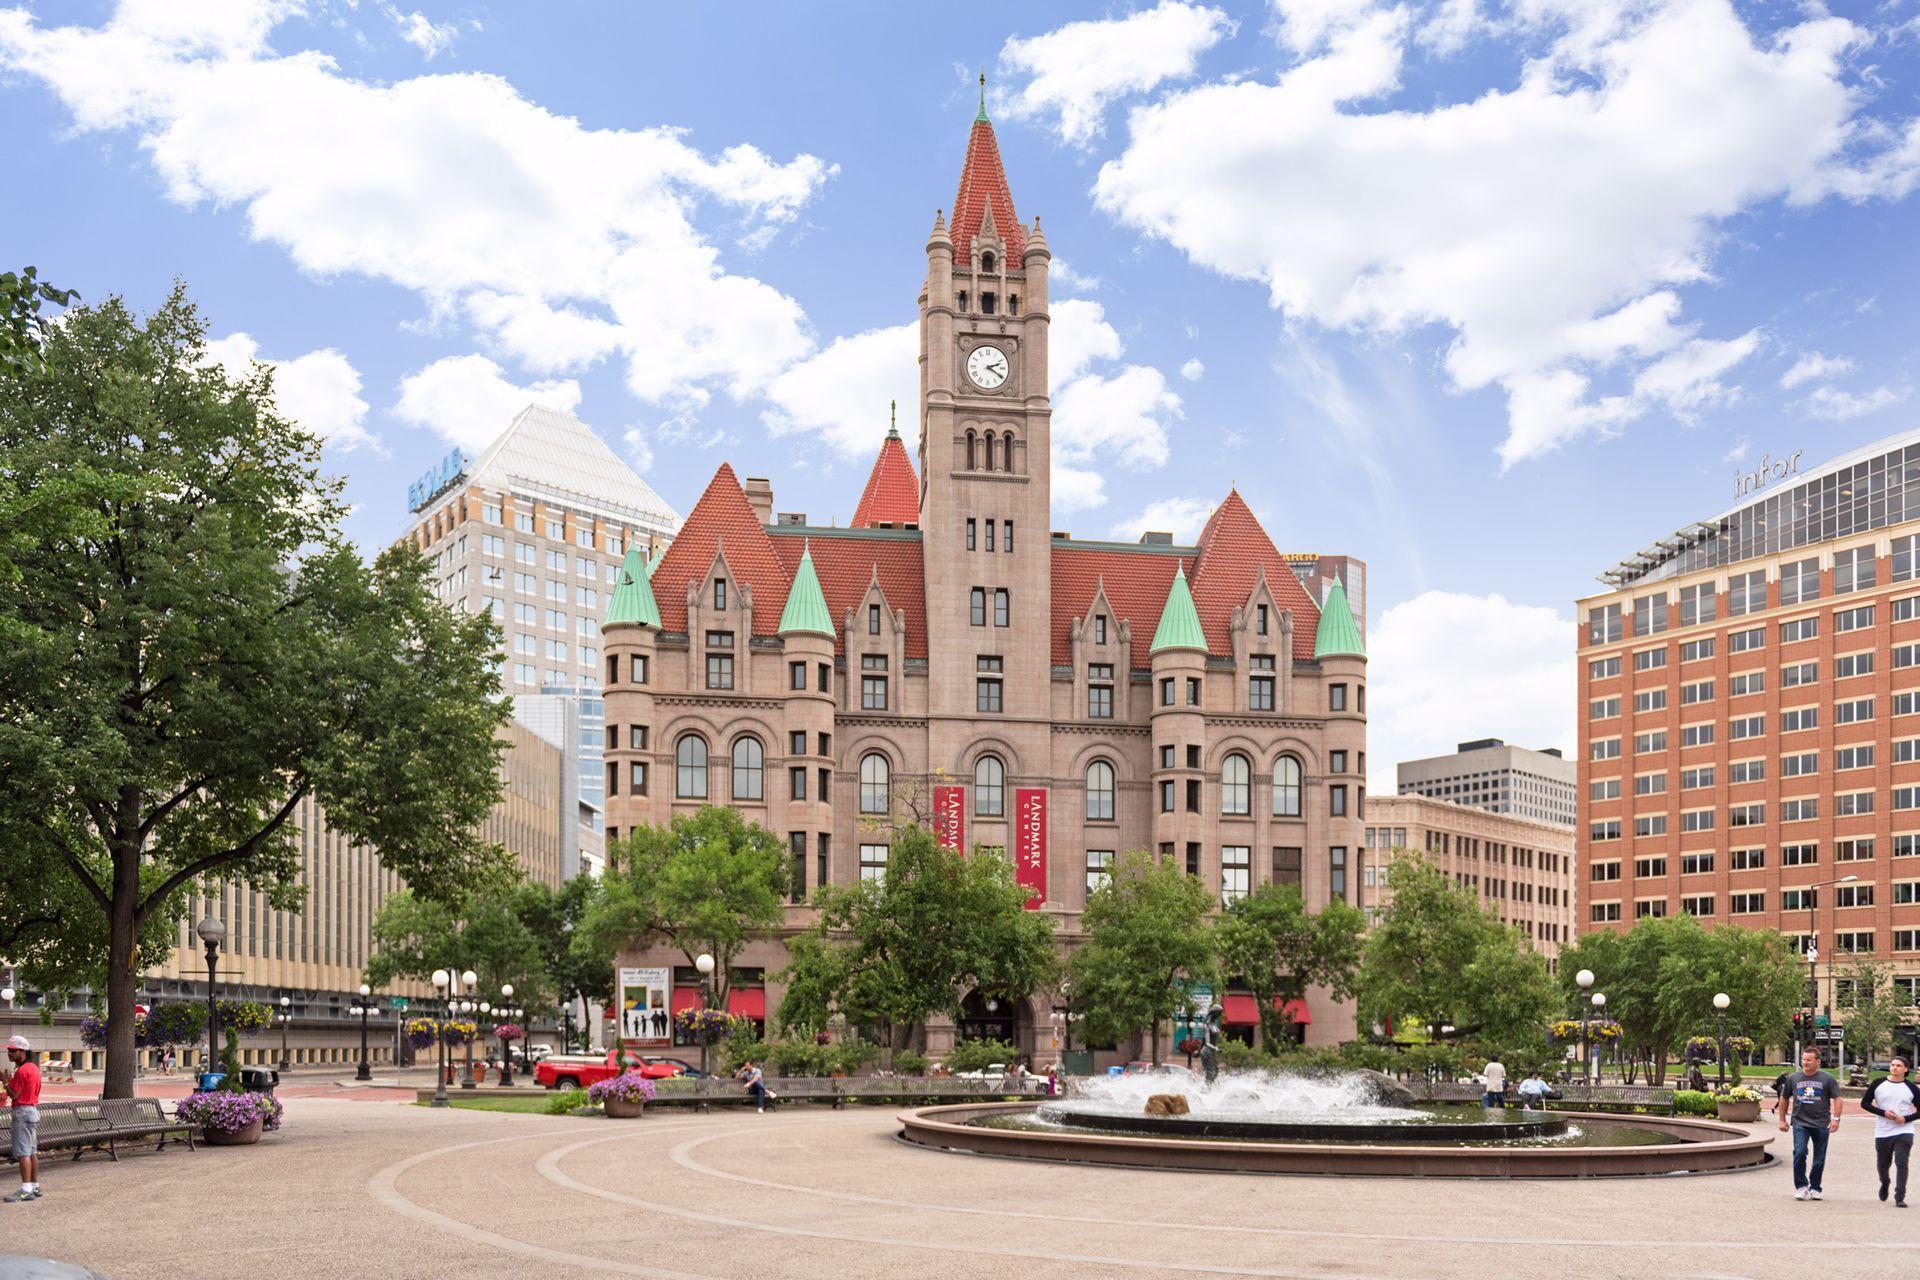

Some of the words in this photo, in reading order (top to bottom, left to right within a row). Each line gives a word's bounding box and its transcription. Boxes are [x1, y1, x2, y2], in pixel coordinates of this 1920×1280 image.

[1734, 449, 1803, 499] infor
[948, 793, 960, 851] LANDMA
[1030, 795, 1042, 869] LANDMARK
